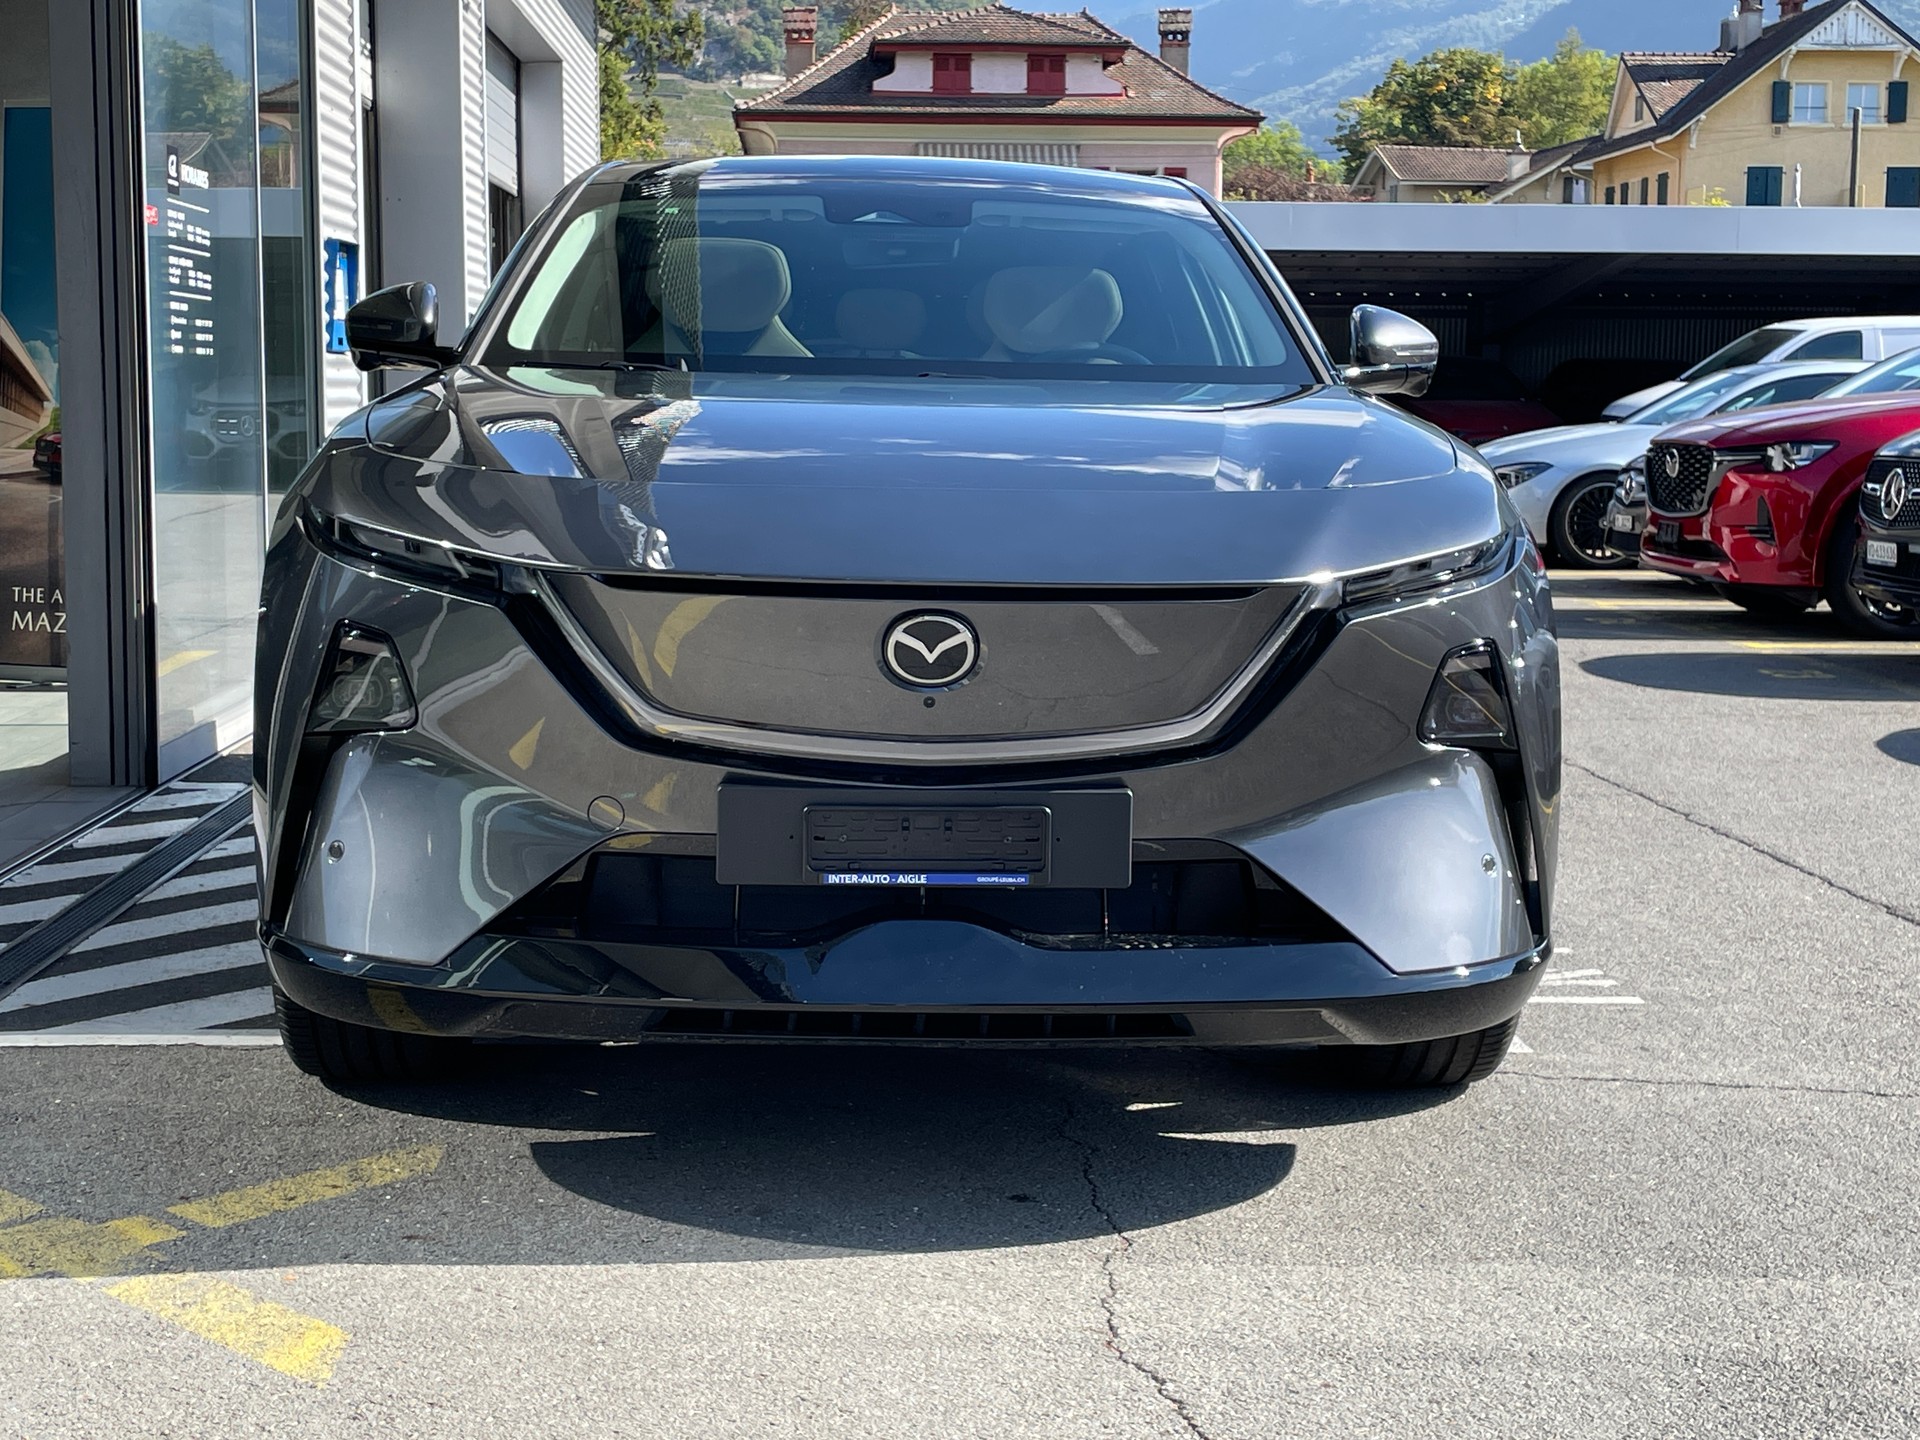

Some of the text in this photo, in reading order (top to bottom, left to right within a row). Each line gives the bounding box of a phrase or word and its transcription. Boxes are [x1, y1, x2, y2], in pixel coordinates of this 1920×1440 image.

[11, 586, 63, 604] THE A
[11, 610, 67, 633] MAZ
[828, 874, 890, 884] INTER-AUTO
[897, 874, 928, 884] AIGLE
